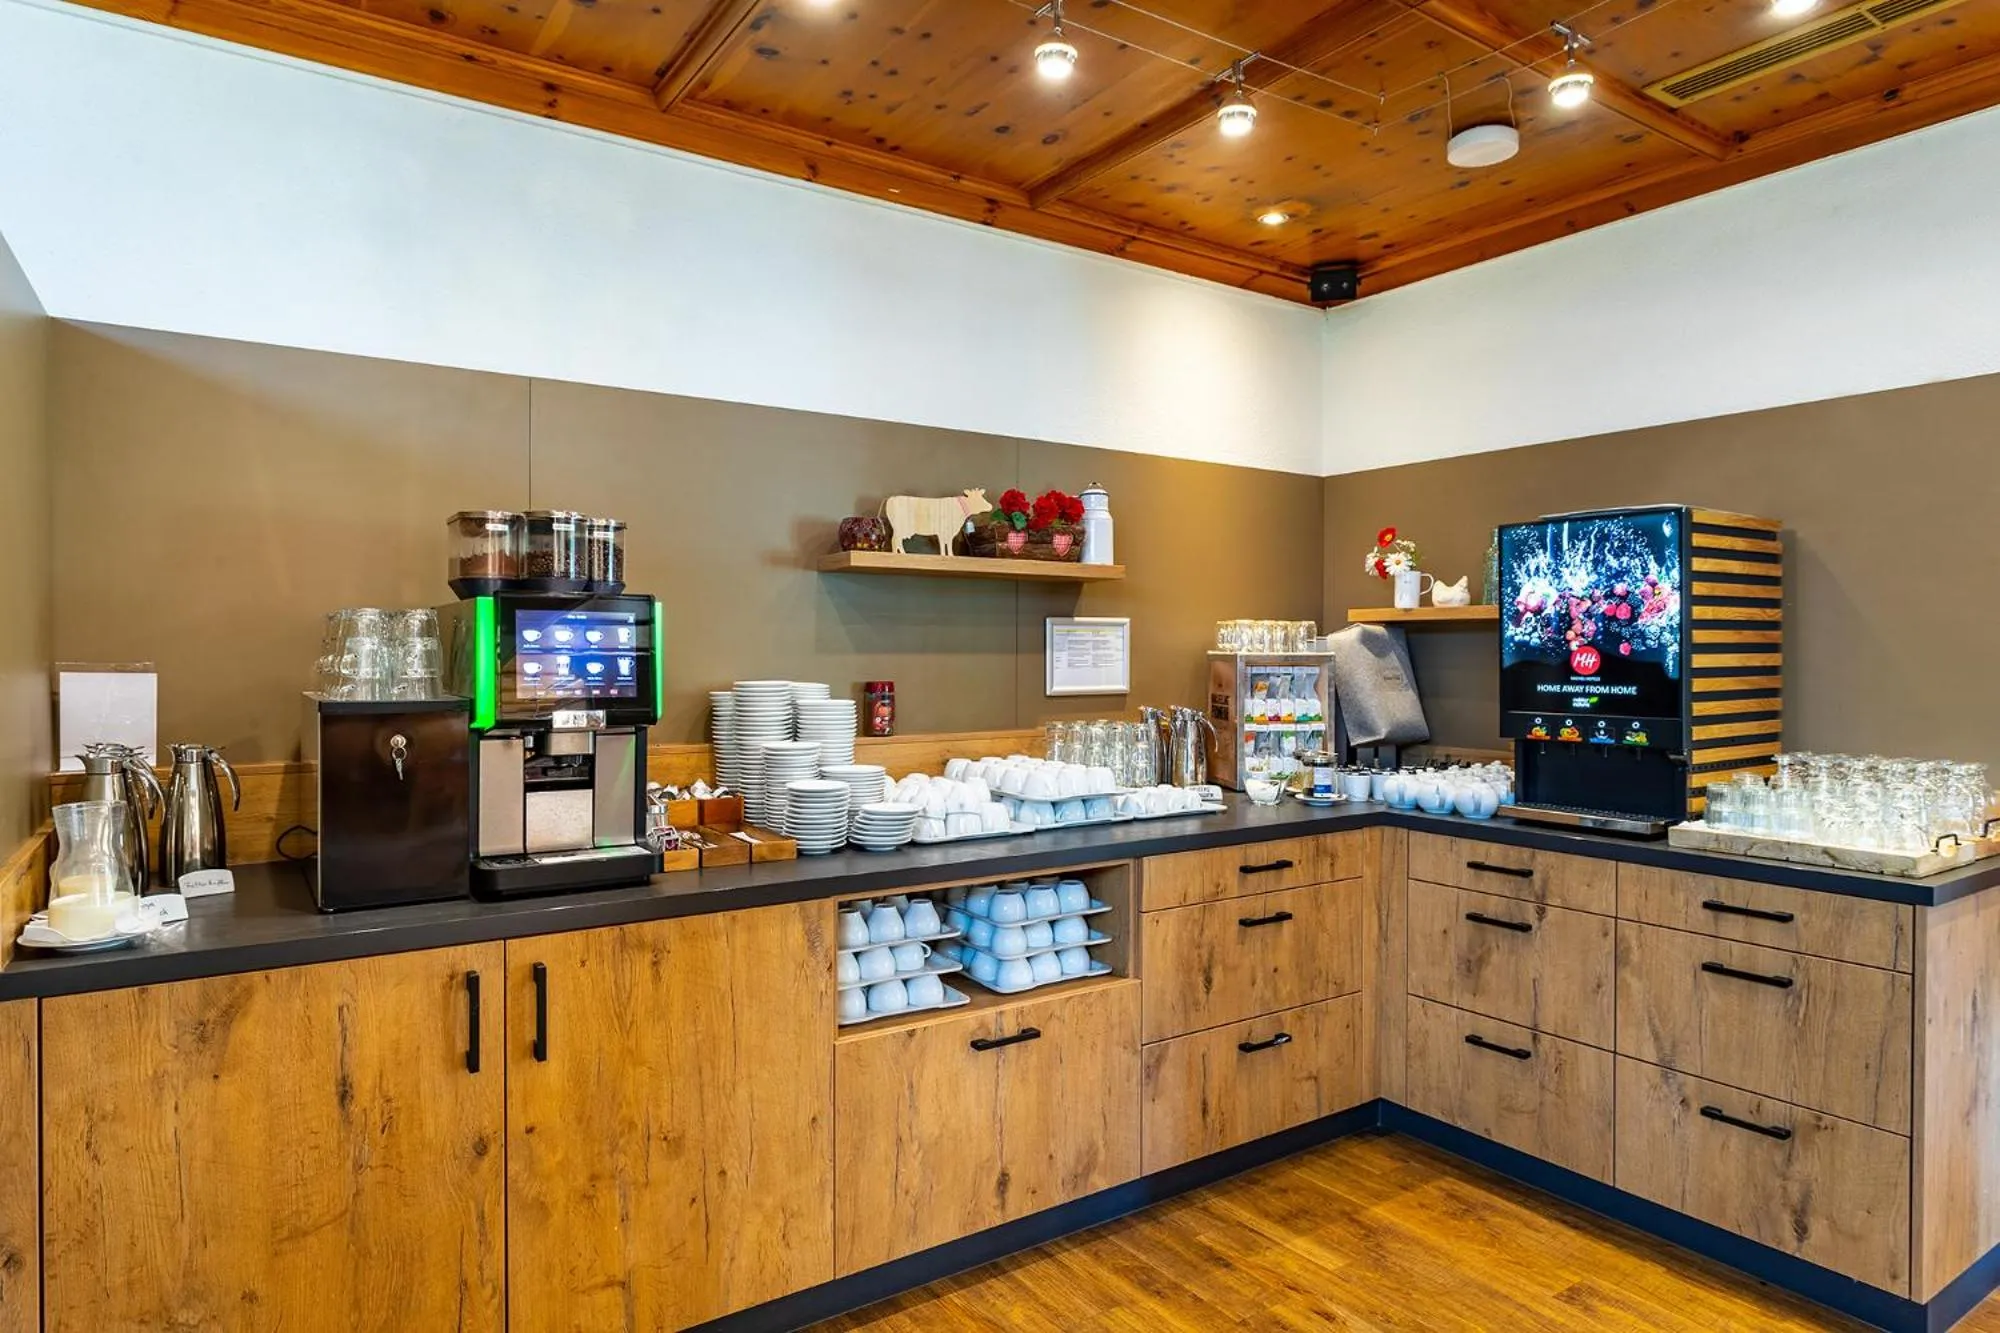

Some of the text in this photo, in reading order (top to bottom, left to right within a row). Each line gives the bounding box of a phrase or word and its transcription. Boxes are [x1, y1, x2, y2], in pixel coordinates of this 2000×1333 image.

[1573, 653, 1597, 668] MH
[1537, 684, 1637, 695] HOME AWAY FROM HOME
